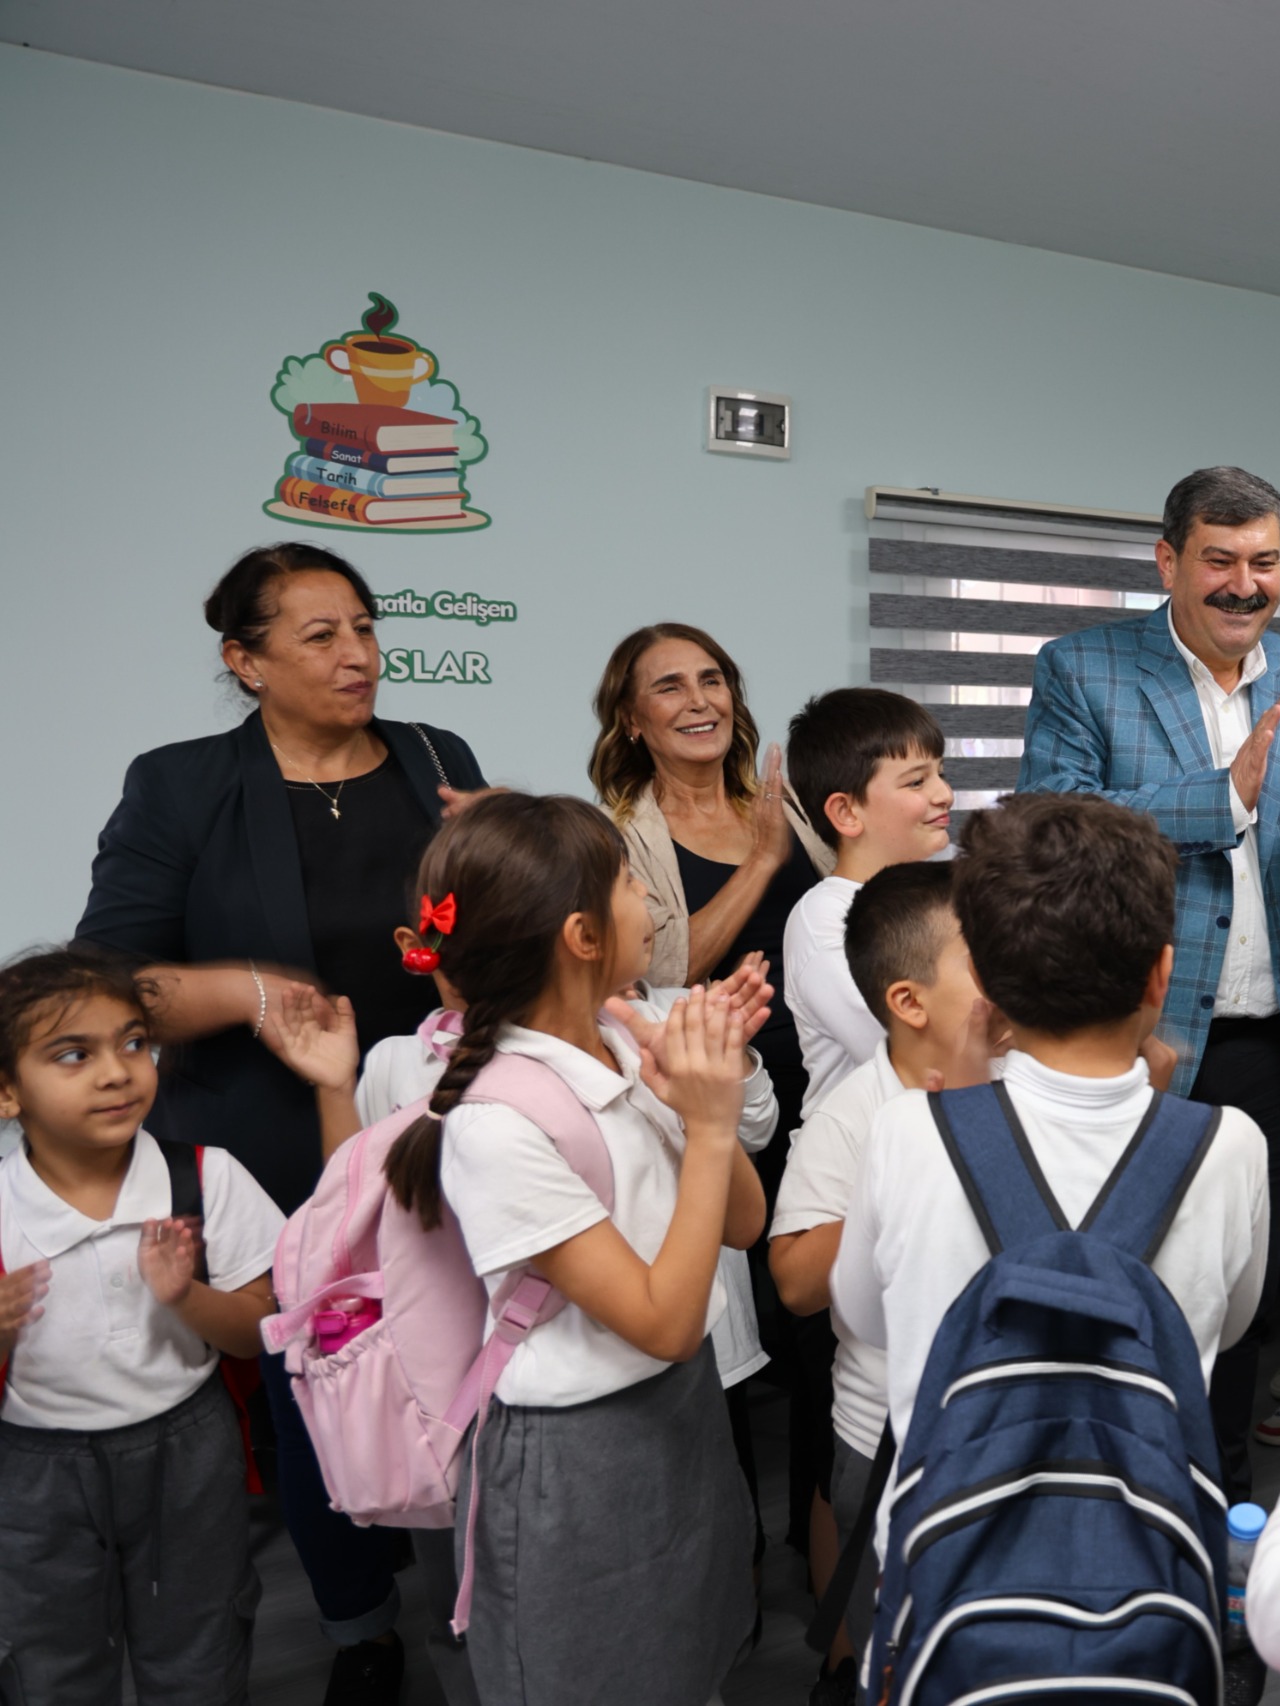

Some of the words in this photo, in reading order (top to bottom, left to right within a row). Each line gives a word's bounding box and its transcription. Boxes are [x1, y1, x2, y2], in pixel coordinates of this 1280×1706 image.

[320, 420, 358, 440] Bilim
[330, 449, 363, 464] Sanat
[315, 466, 358, 486] Tarih
[298, 491, 356, 514] Felsefe
[433, 593, 515, 623] Gelişen
[380, 649, 491, 682] SLAR
